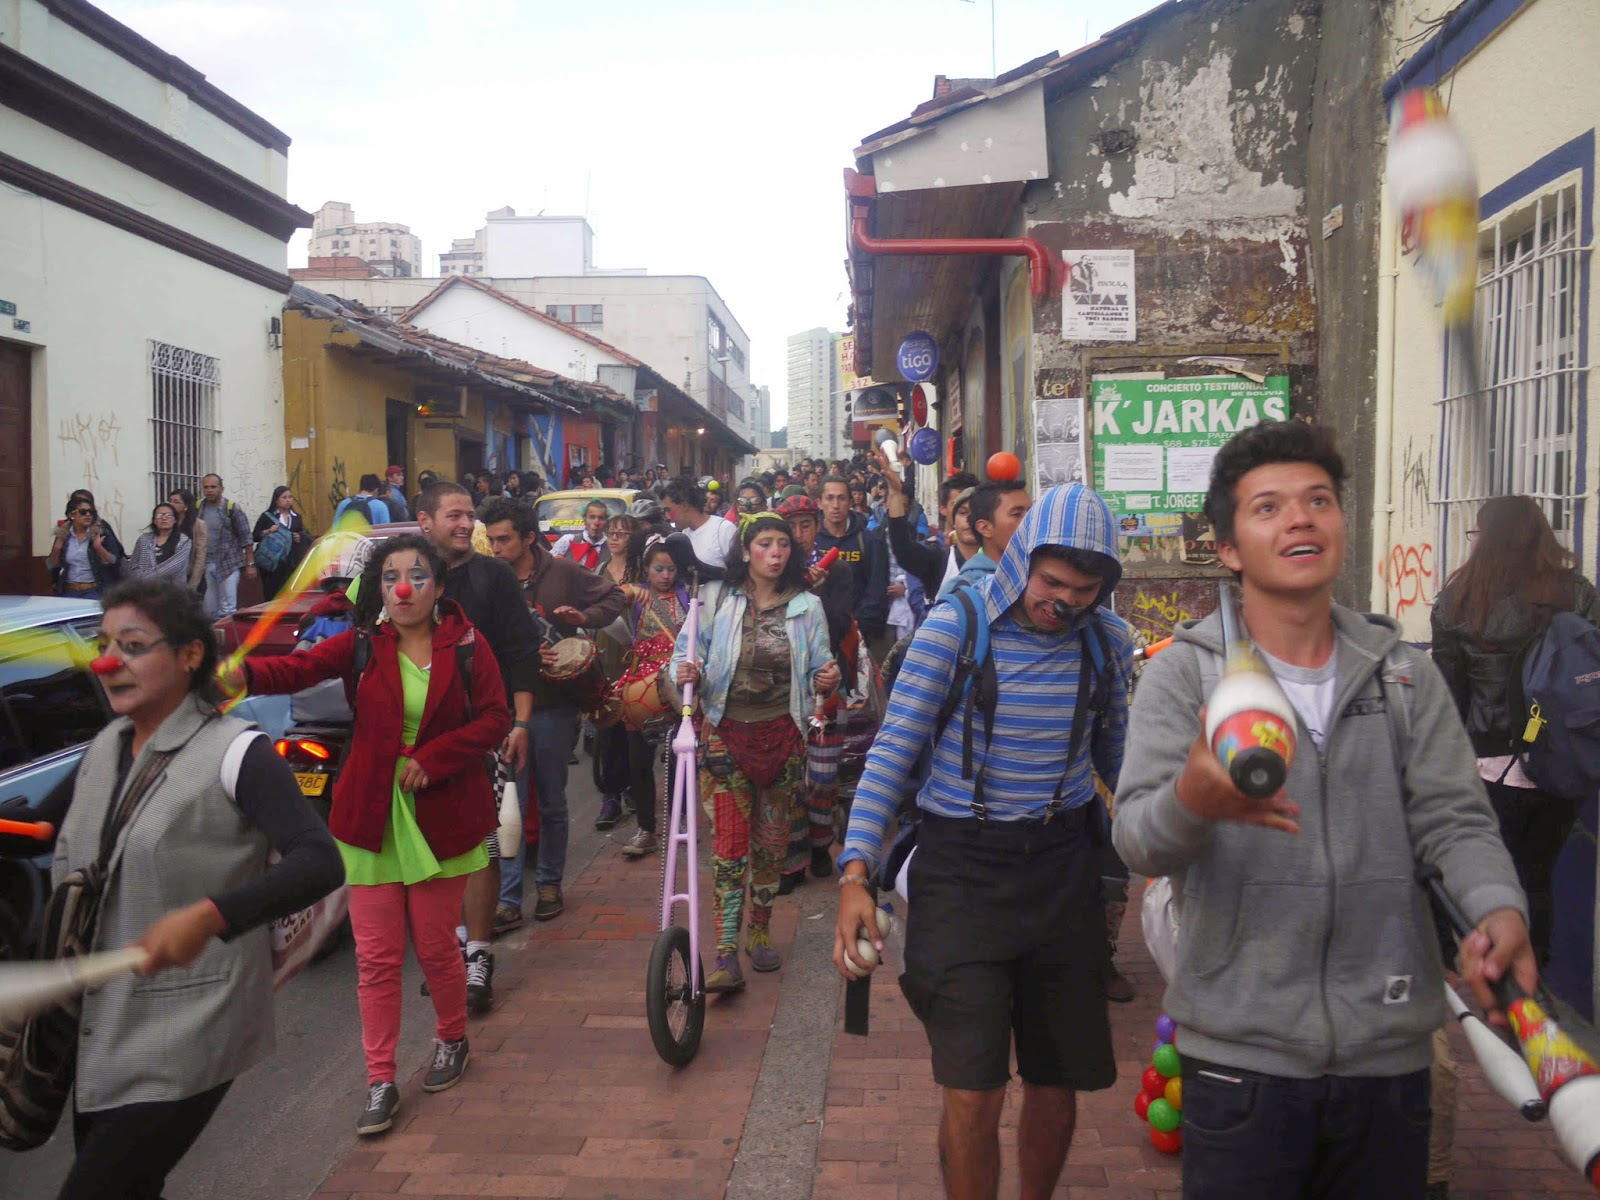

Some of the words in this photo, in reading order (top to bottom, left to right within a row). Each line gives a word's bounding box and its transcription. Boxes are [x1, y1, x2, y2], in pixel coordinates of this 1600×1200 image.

[1146, 383, 1202, 393] CONCIERTO
[1204, 382, 1268, 391] TESTIMONIAL
[1163, 494, 1199, 508] JORGE
